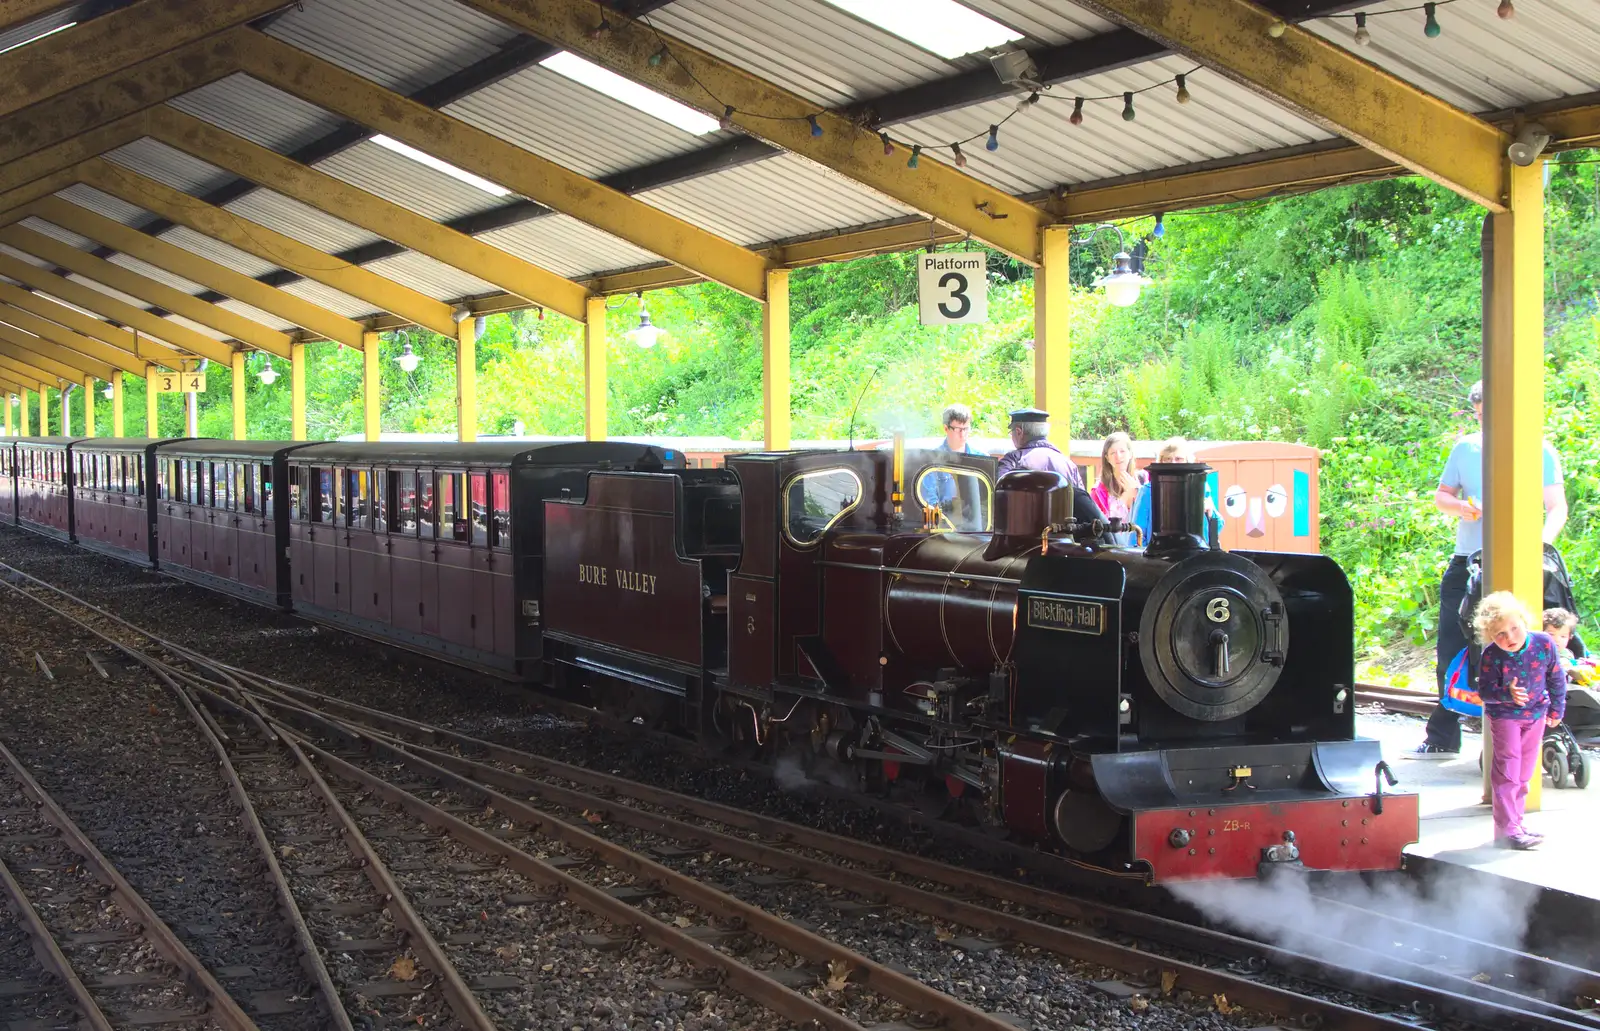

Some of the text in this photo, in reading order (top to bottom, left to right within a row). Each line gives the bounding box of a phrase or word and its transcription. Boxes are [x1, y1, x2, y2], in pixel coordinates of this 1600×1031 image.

[925, 258, 980, 270] Platform
[938, 272, 971, 319] 3
[163, 377, 172, 391] 3
[190, 377, 199, 390] 4
[579, 563, 657, 595] BURE VALLEY
[1033, 600, 1096, 627] Blickling Hall
[1206, 597, 1230, 623] 6
[1223, 819, 1251, 832] ZB-R
